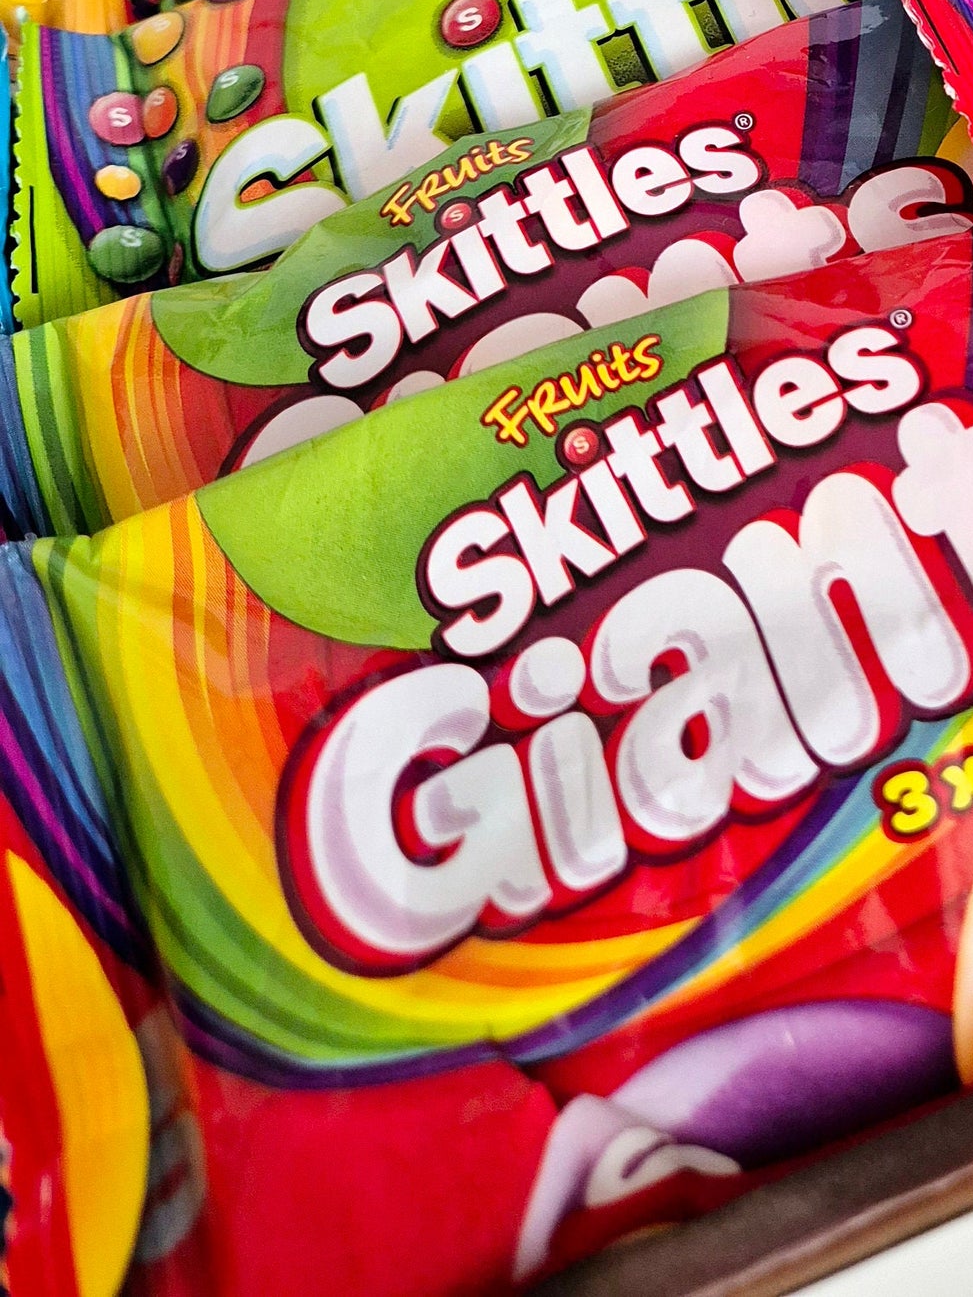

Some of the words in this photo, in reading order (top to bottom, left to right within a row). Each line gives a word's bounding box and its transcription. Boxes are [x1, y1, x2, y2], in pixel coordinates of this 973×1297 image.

[381, 136, 535, 227] Fruits
[306, 126, 760, 389] Skittles
[483, 332, 664, 446] Fruits
[430, 326, 920, 655] Skittles
[883, 771, 938, 833] 3
